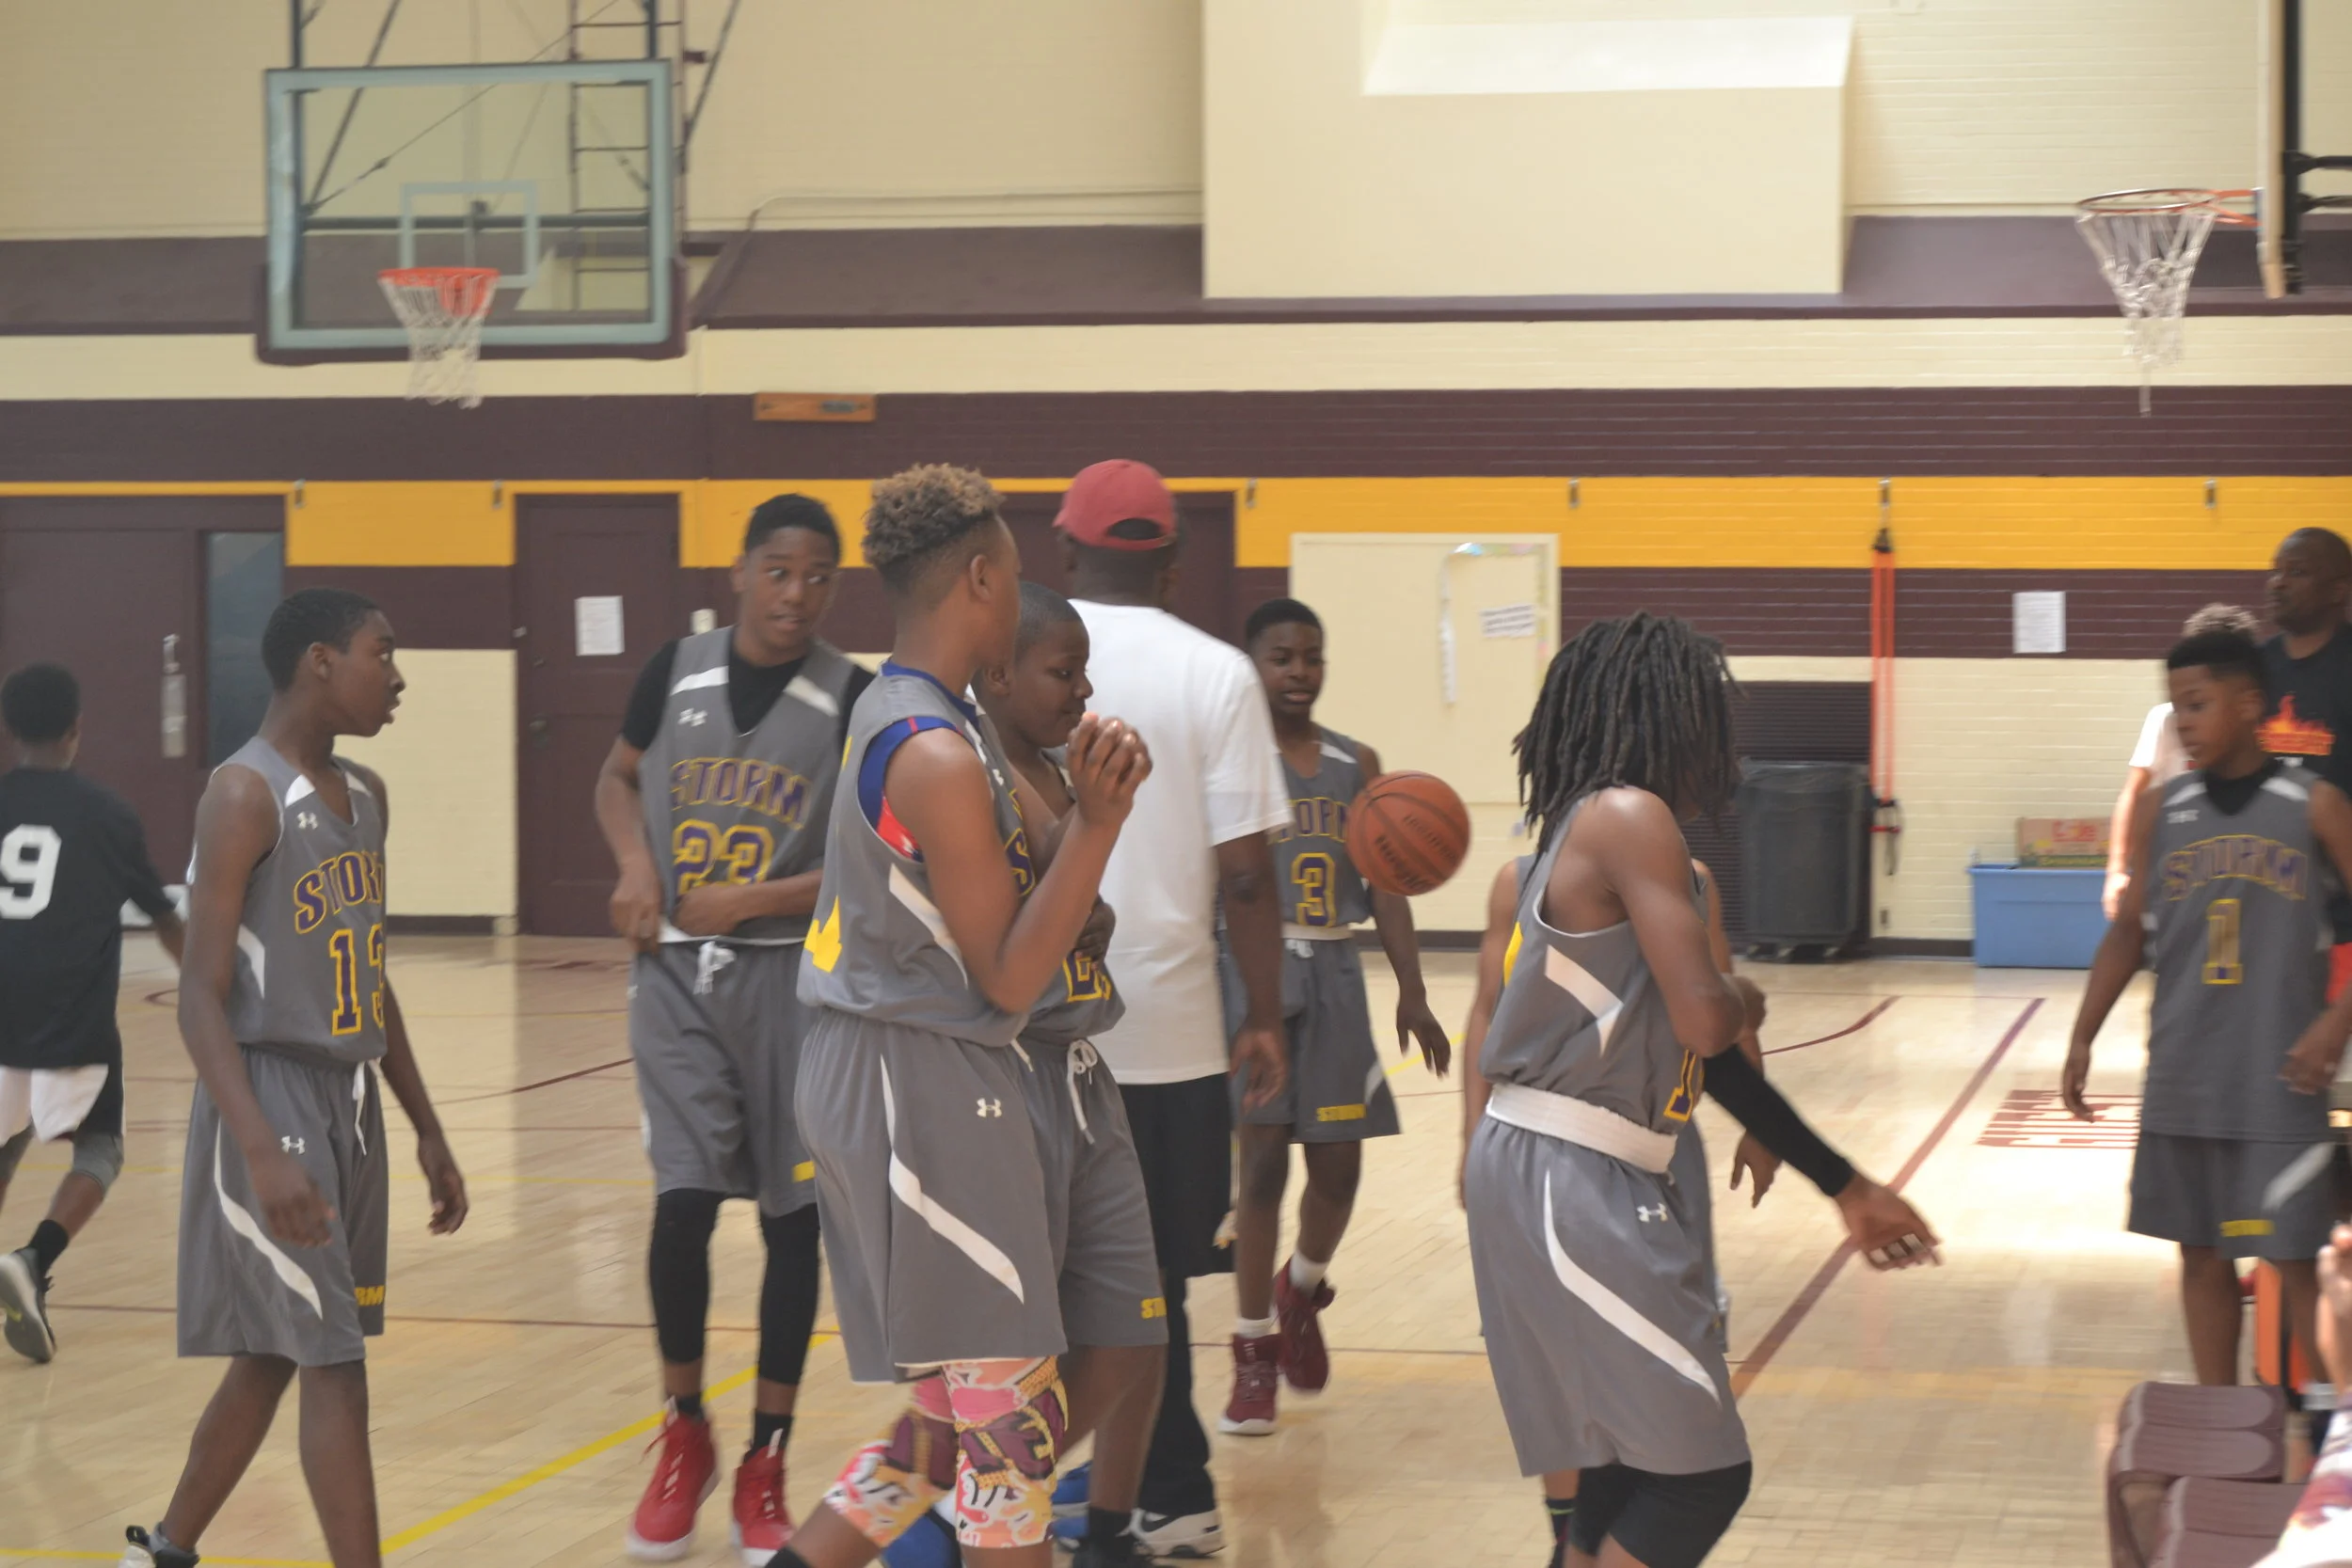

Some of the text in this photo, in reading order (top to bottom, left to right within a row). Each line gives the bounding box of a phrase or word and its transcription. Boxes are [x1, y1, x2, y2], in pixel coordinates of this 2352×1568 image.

[0, 824, 62, 920] 9
[294, 851, 386, 934] STOR
[1292, 852, 1337, 927] 3
[2161, 834, 2308, 900] STORM
[2202, 899, 2243, 984] 1
